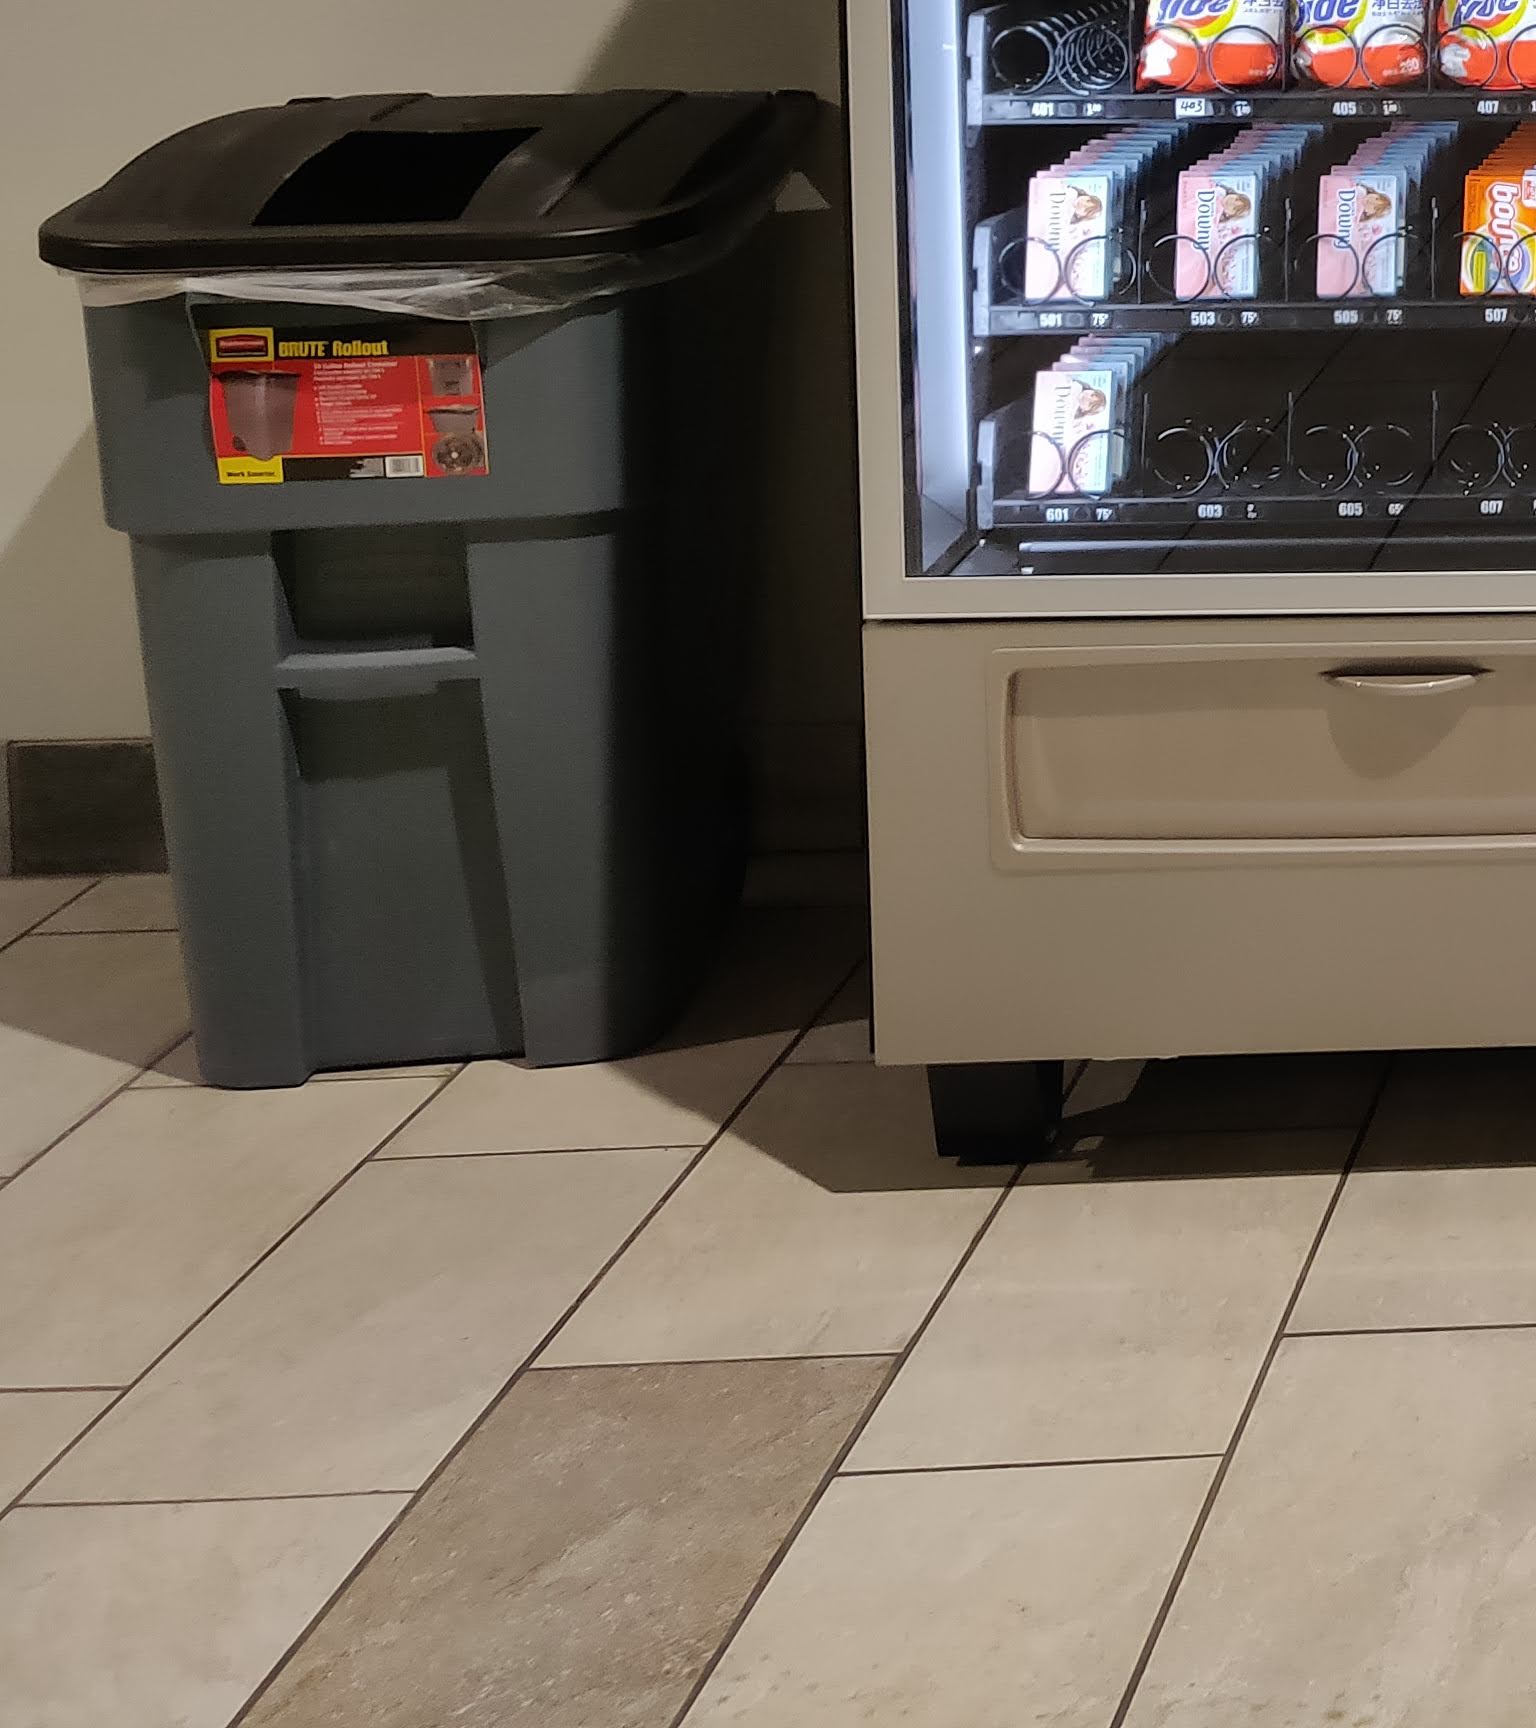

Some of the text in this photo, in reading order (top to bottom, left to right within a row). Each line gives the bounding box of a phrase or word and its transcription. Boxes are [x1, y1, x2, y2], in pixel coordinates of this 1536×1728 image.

[1180, 99, 1206, 114] 403
[1195, 189, 1215, 252] Downy
[1335, 189, 1356, 250] Downy
[1484, 308, 1508, 323] 507
[278, 342, 327, 357] BRUTE
[332, 339, 389, 356] Rollout
[1045, 507, 1069, 522] 601
